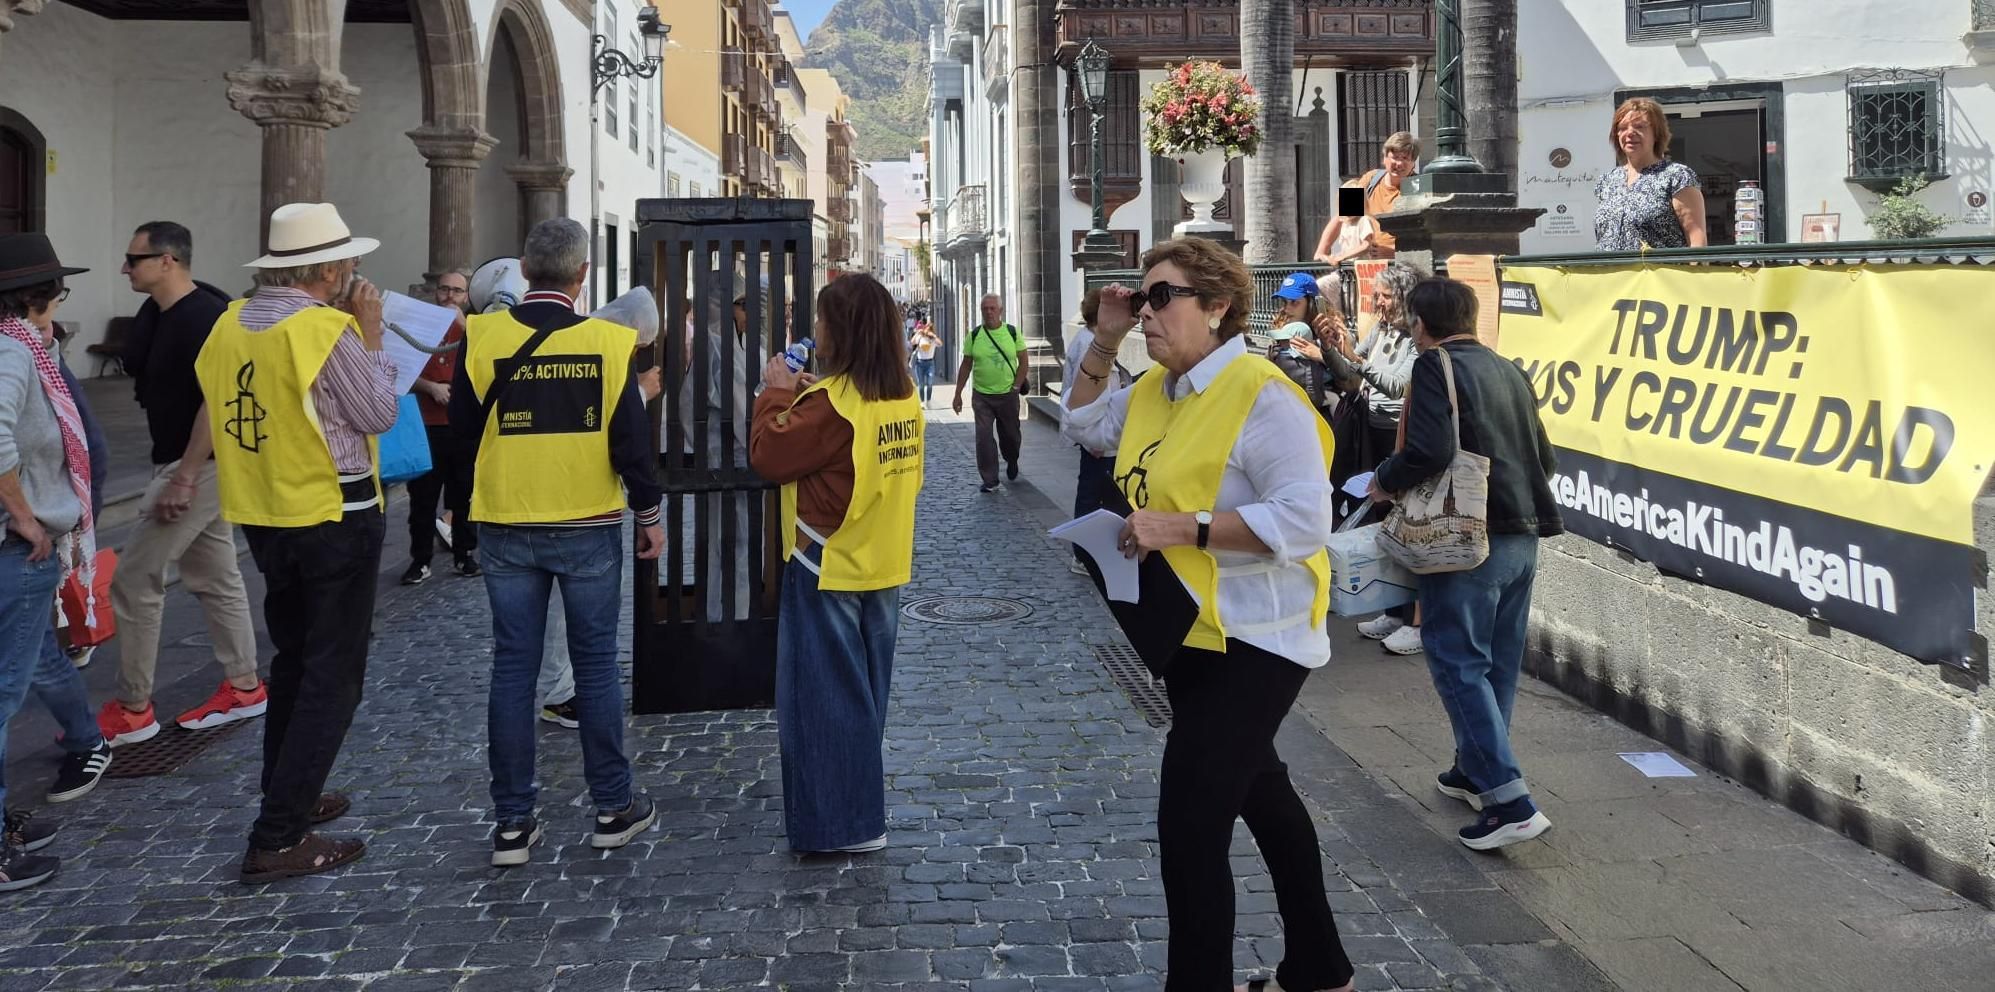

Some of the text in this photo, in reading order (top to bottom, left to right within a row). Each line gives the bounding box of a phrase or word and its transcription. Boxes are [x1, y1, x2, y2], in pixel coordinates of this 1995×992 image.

[535, 363, 598, 379] ACTIVISTA
[1608, 298, 1810, 380] TRUMP:
[503, 411, 532, 421] MNISTÍA
[1512, 357, 1956, 486] OS Y CRUELDAD
[1548, 469, 1897, 615] keAmericaKindAgain
